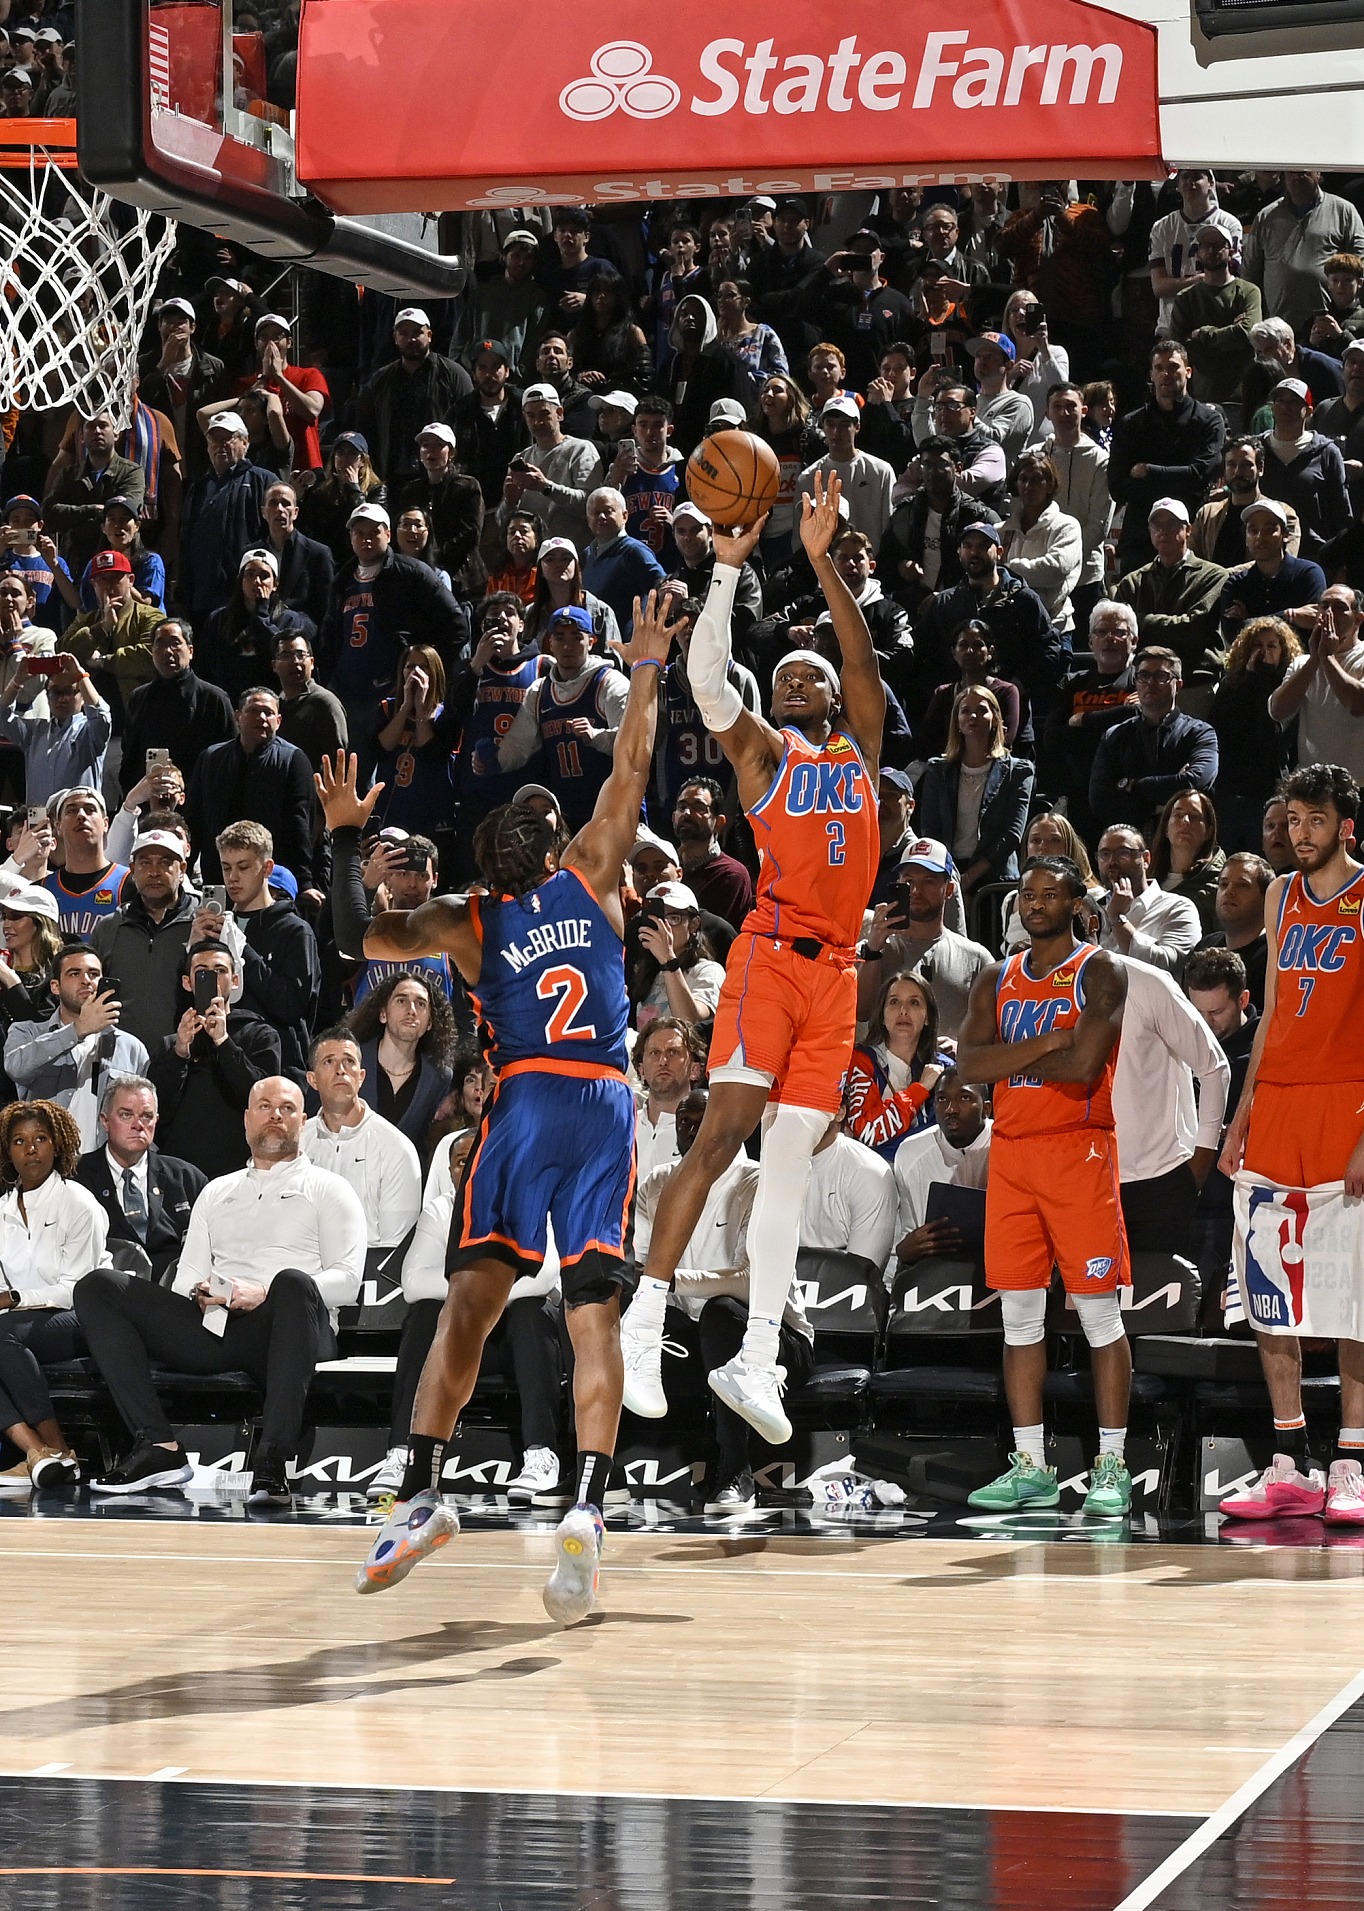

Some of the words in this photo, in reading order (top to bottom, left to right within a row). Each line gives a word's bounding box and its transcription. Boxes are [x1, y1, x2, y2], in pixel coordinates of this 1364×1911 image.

[690, 36, 908, 116] State
[911, 30, 1124, 109] Farm
[595, 175, 805, 201] State
[813, 172, 1014, 190] Farm
[625, 492, 651, 514] EW
[652, 491, 675, 511] YO
[639, 518, 664, 552] 3
[350, 613, 370, 648] 5
[556, 740, 584, 779] 11
[680, 732, 723, 765] 30
[394, 752, 416, 787] 9
[785, 761, 863, 817] OKC
[825, 820, 846, 866] 2
[500, 918, 592, 974] McBRIDE
[1277, 923, 1357, 973] OKC
[536, 963, 597, 1045] 2
[1295, 976, 1316, 1018] 7
[1001, 997, 1072, 1045] OKC
[859, 1102, 903, 1147] NEW
[796, 1280, 868, 1310] IA
[1065, 1281, 1183, 1310] IA
[1252, 1293, 1282, 1320] NBA
[441, 1455, 513, 1485] KI
